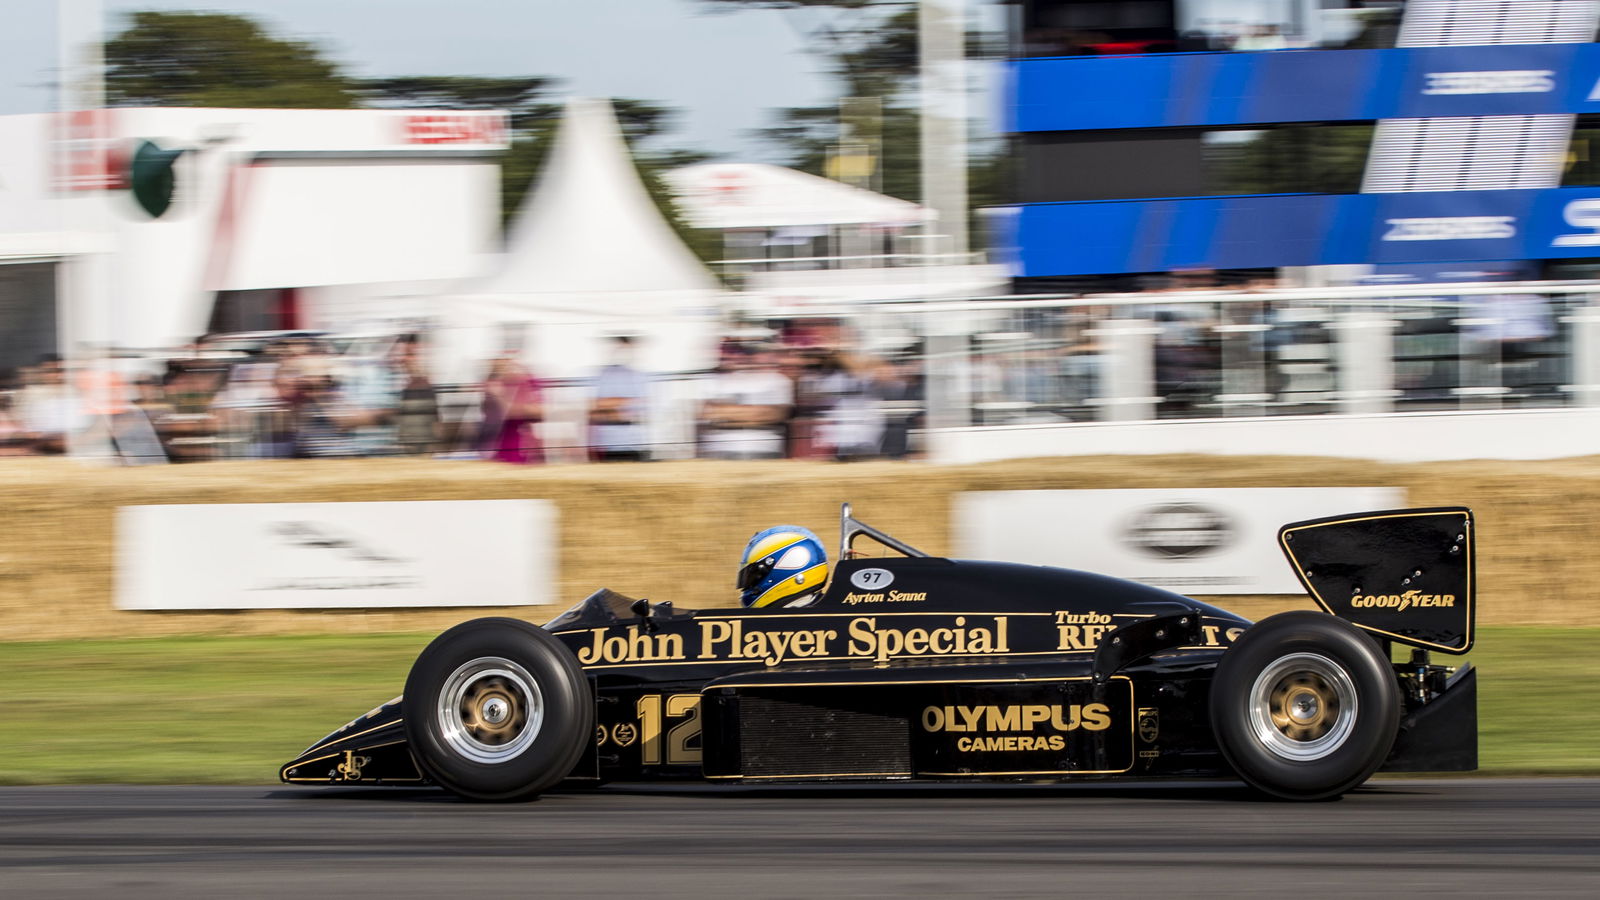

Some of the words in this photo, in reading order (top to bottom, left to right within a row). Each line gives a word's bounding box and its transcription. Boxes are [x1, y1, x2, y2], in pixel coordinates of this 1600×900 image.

[862, 573, 882, 584] 97
[842, 591, 885, 605] Ayrton
[887, 590, 927, 603] Senna
[1055, 610, 1112, 625] Turbo
[577, 624, 687, 664] John
[697, 620, 837, 667] Player
[848, 616, 1010, 662] Special
[922, 703, 1112, 733] OLYMPUS
[637, 694, 703, 765] 12
[957, 735, 1066, 752] CAMERAS
